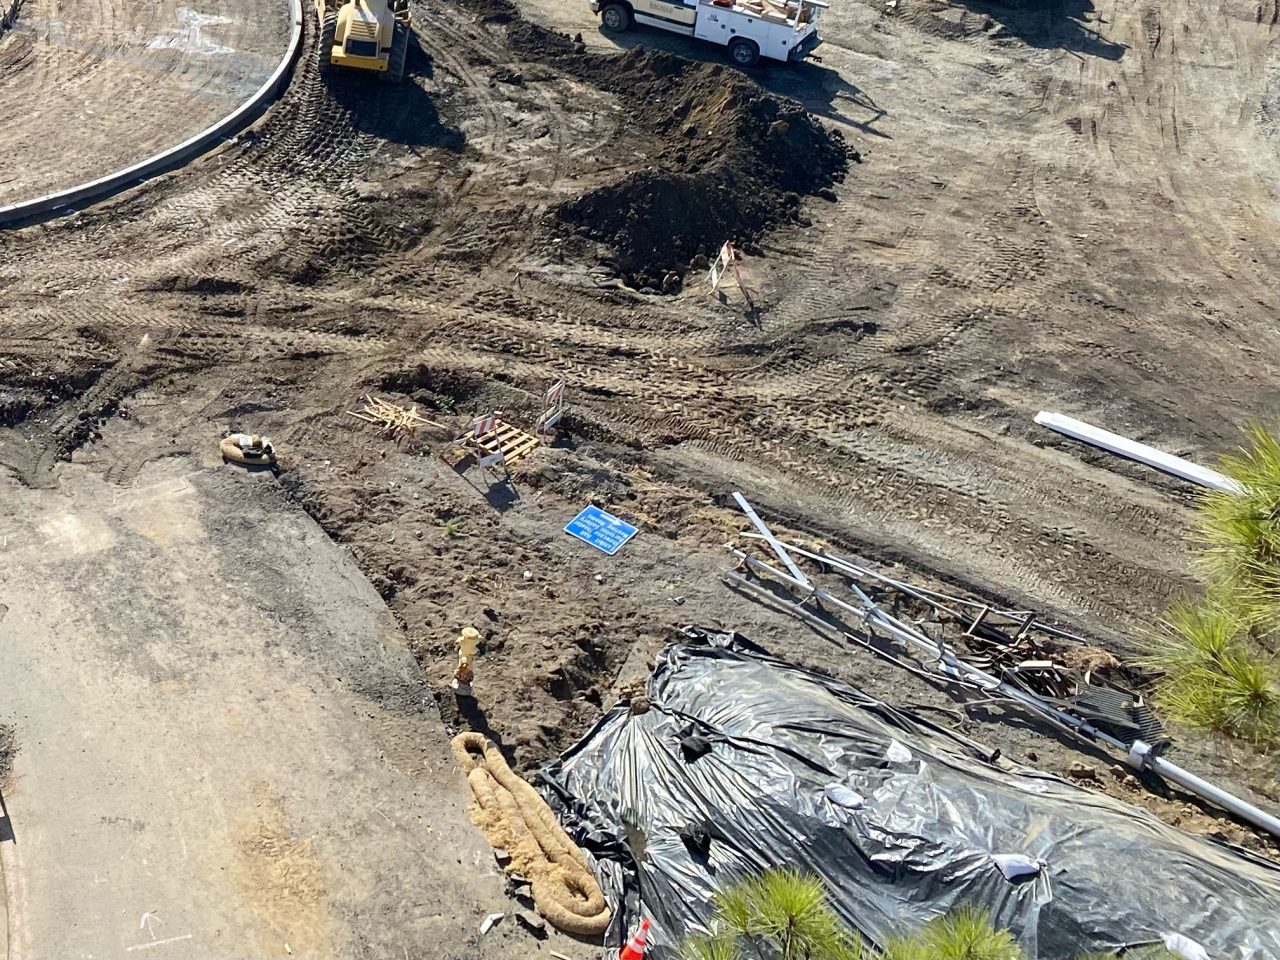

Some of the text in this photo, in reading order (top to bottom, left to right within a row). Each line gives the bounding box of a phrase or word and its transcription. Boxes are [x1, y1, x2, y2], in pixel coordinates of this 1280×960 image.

[606, 524, 629, 538] Meeting
[578, 530, 615, 551] Exhibit Hall
